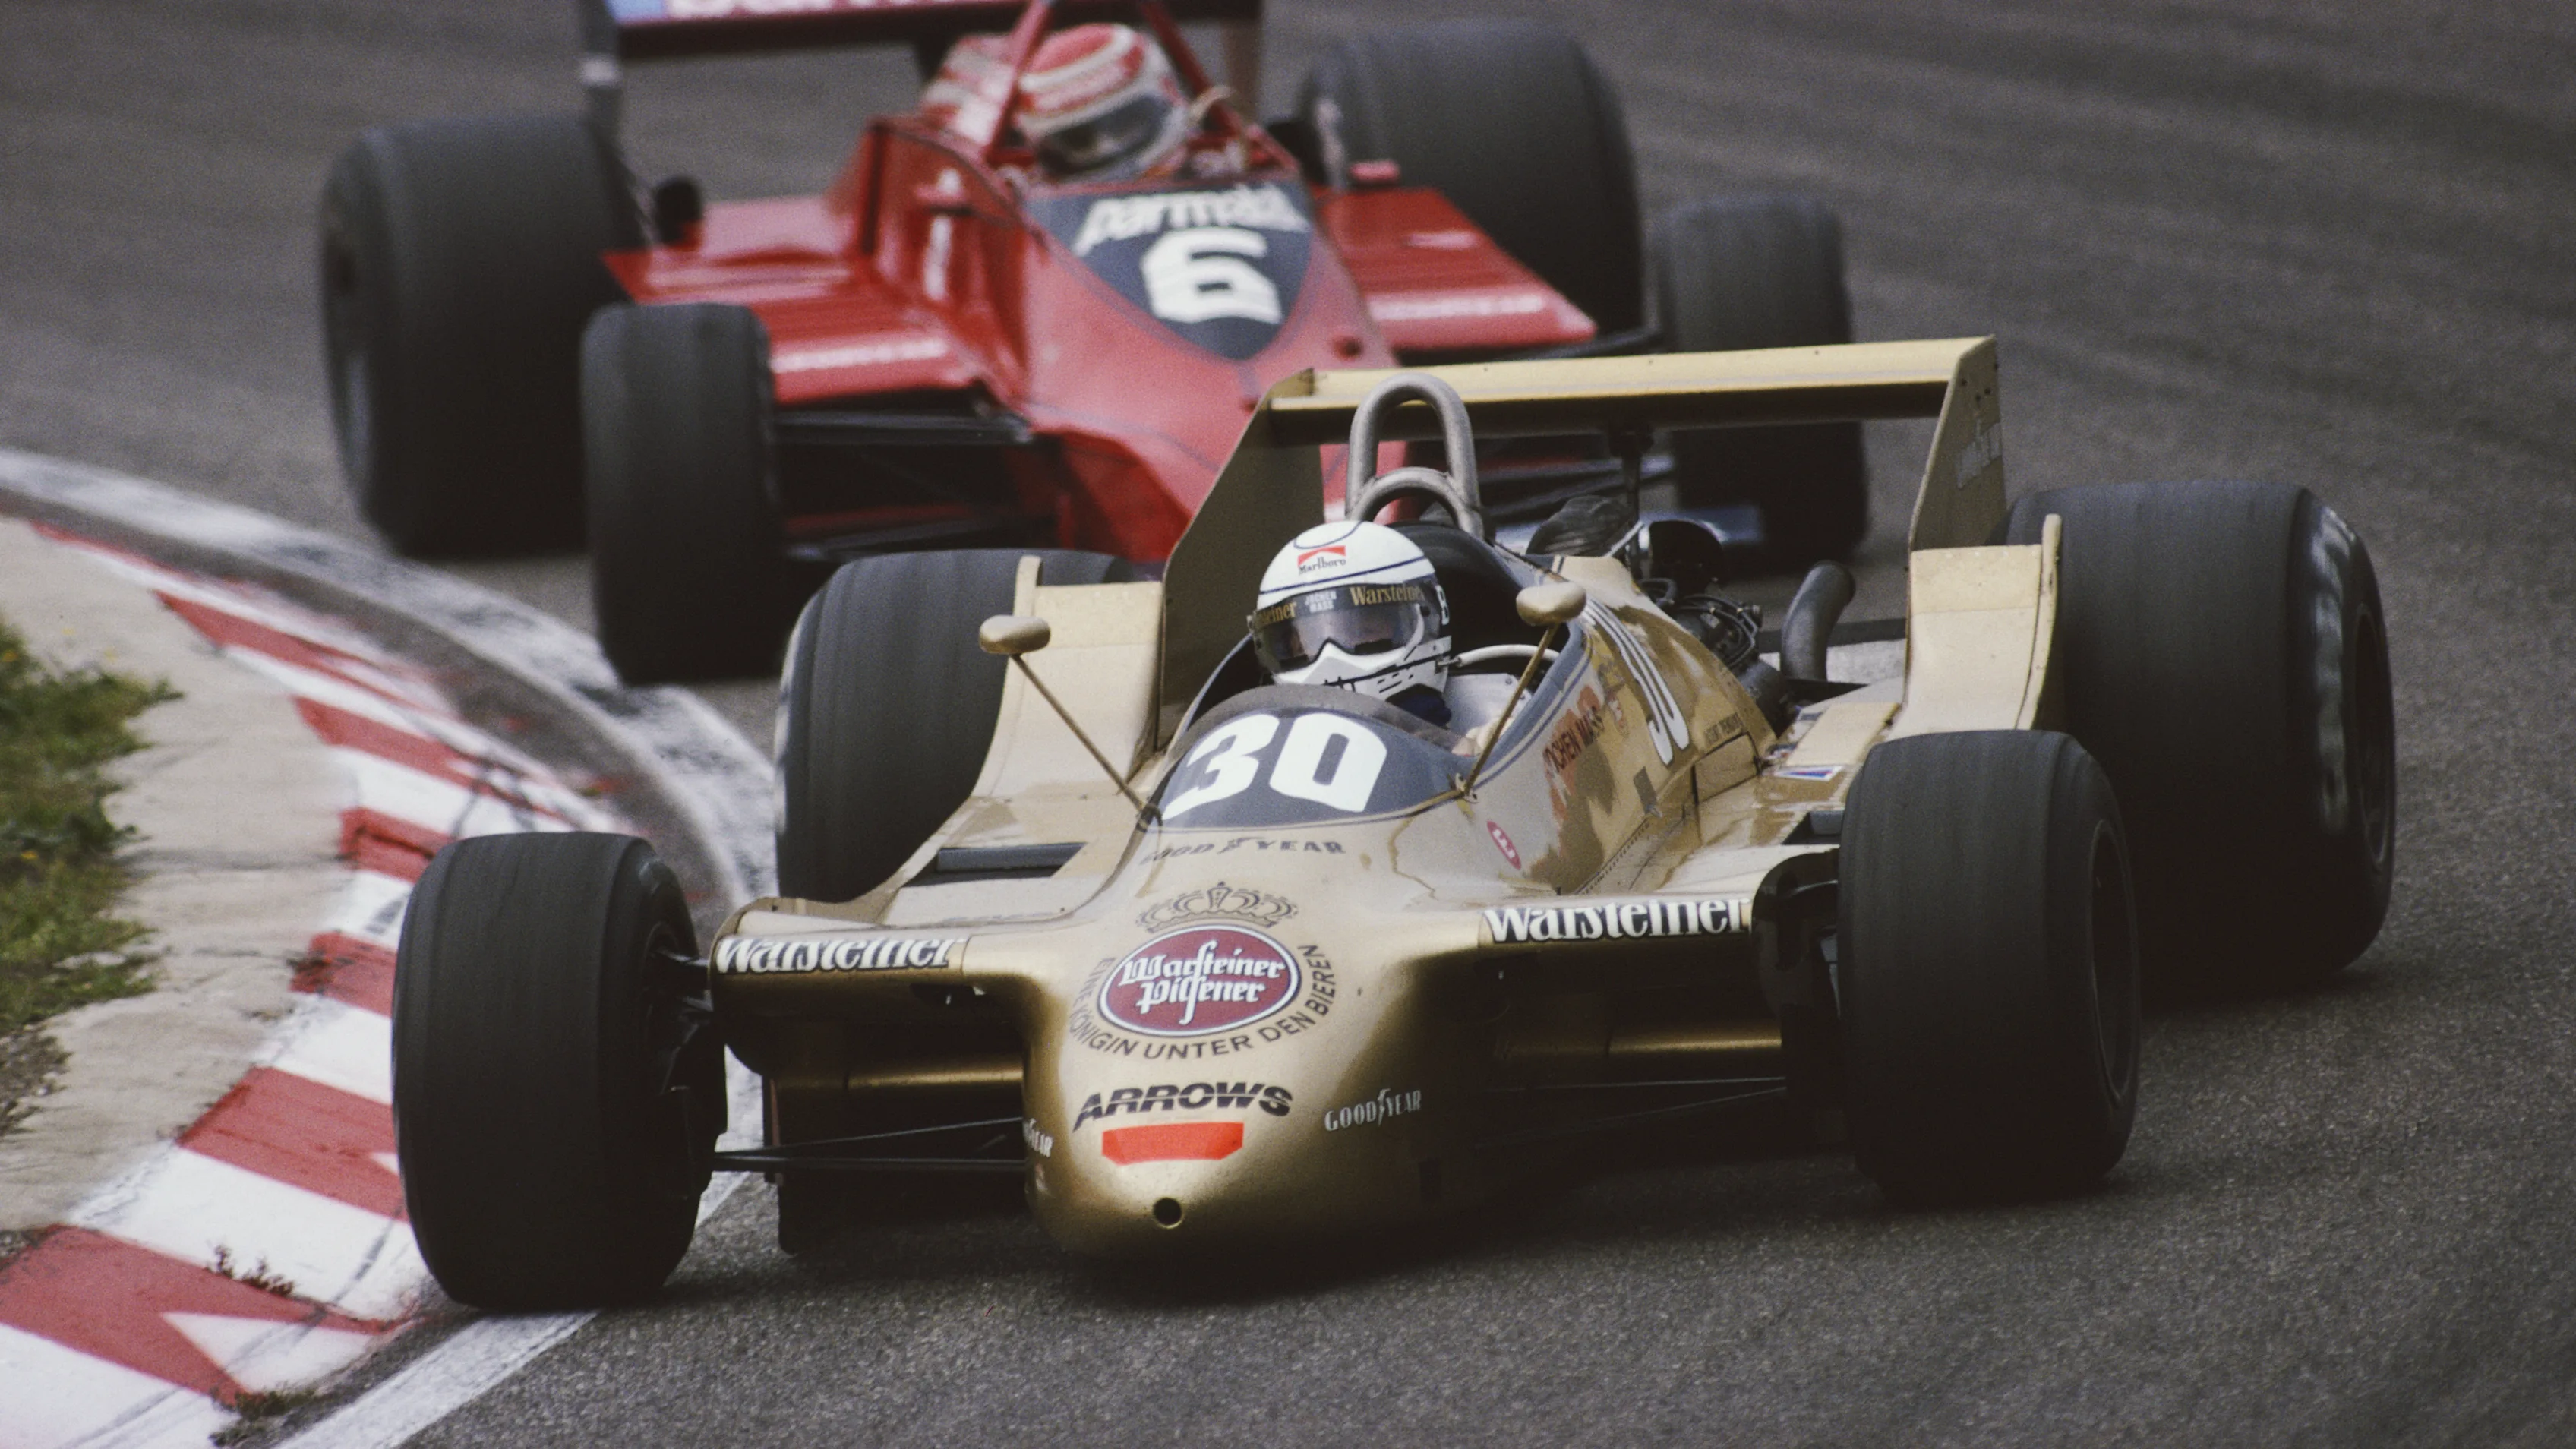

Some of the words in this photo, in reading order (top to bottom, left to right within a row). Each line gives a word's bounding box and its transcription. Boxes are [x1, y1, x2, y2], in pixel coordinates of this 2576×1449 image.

[1139, 226, 1283, 324] 6
[1299, 557, 1346, 575] Marlboro
[1162, 712, 1387, 821] 30
[1483, 899, 1749, 942] Warsteiner
[715, 937, 963, 974] Warsteiner
[1142, 1034, 1254, 1061] UNTER
[1258, 1010, 1315, 1043] DEN
[1297, 943, 1337, 1018] BIEREN
[1072, 1081, 1294, 1133] ARROWS
